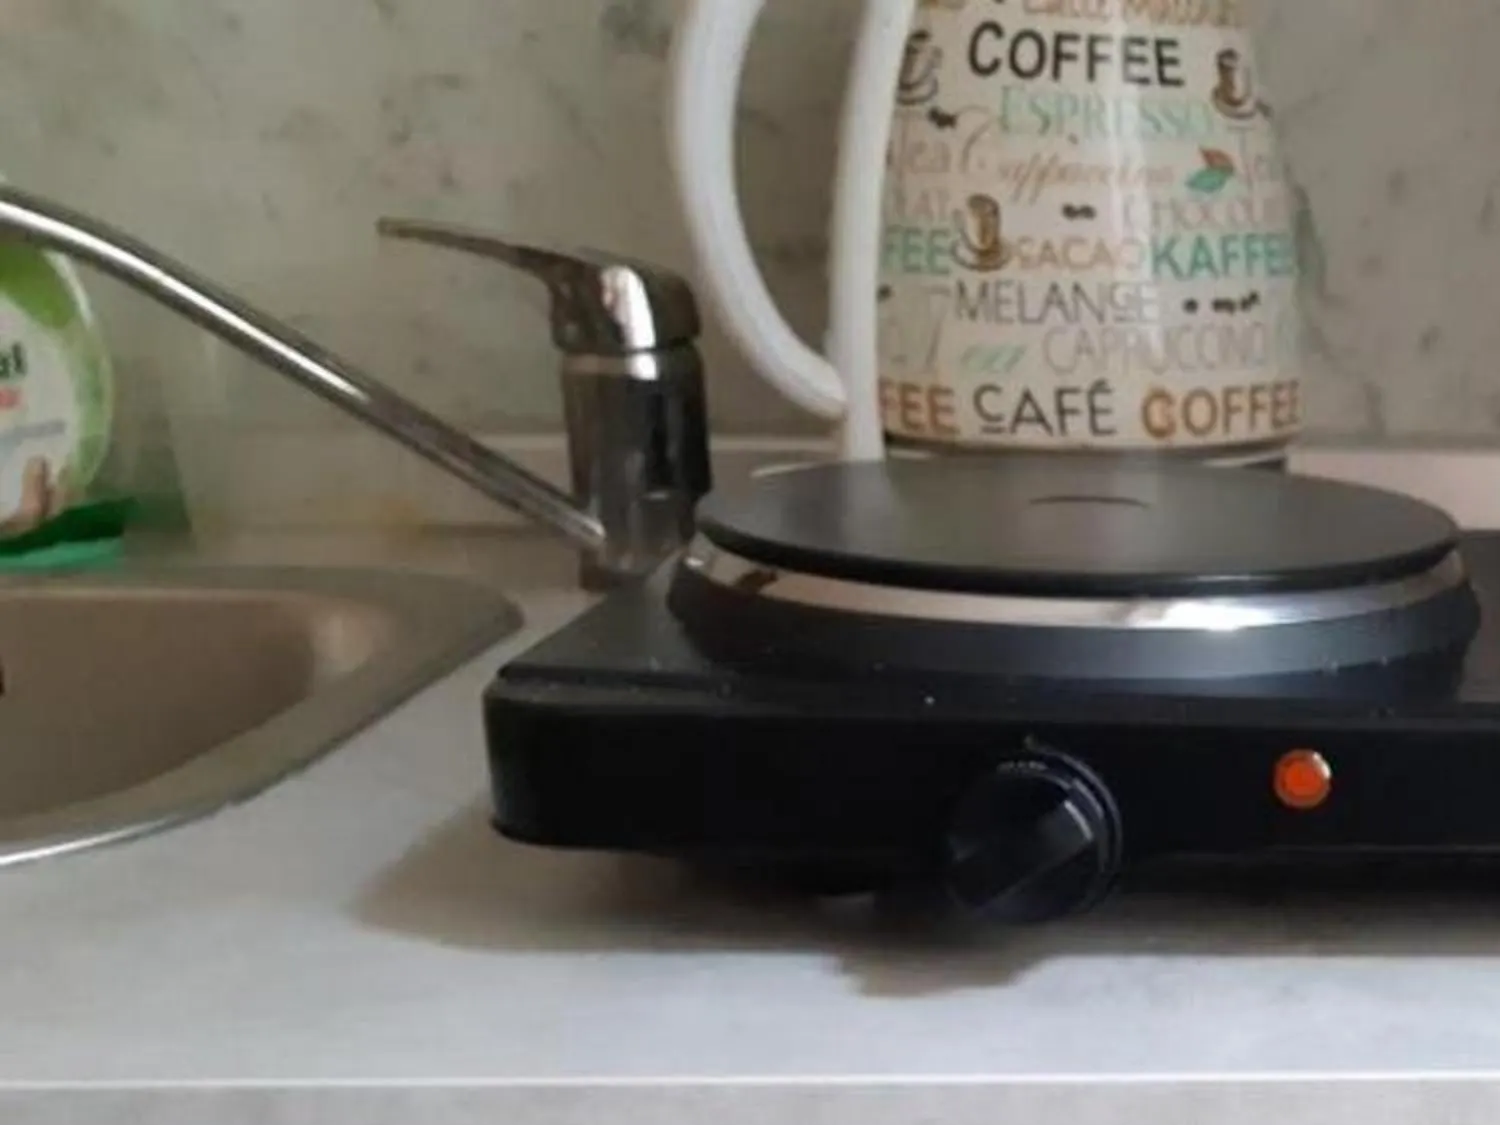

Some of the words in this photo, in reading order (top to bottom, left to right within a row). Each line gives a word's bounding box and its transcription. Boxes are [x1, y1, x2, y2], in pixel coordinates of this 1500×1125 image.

[967, 20, 1186, 87] COFFEE
[955, 279, 1158, 326] MELANGE
[973, 379, 1118, 438] CAFÉ
